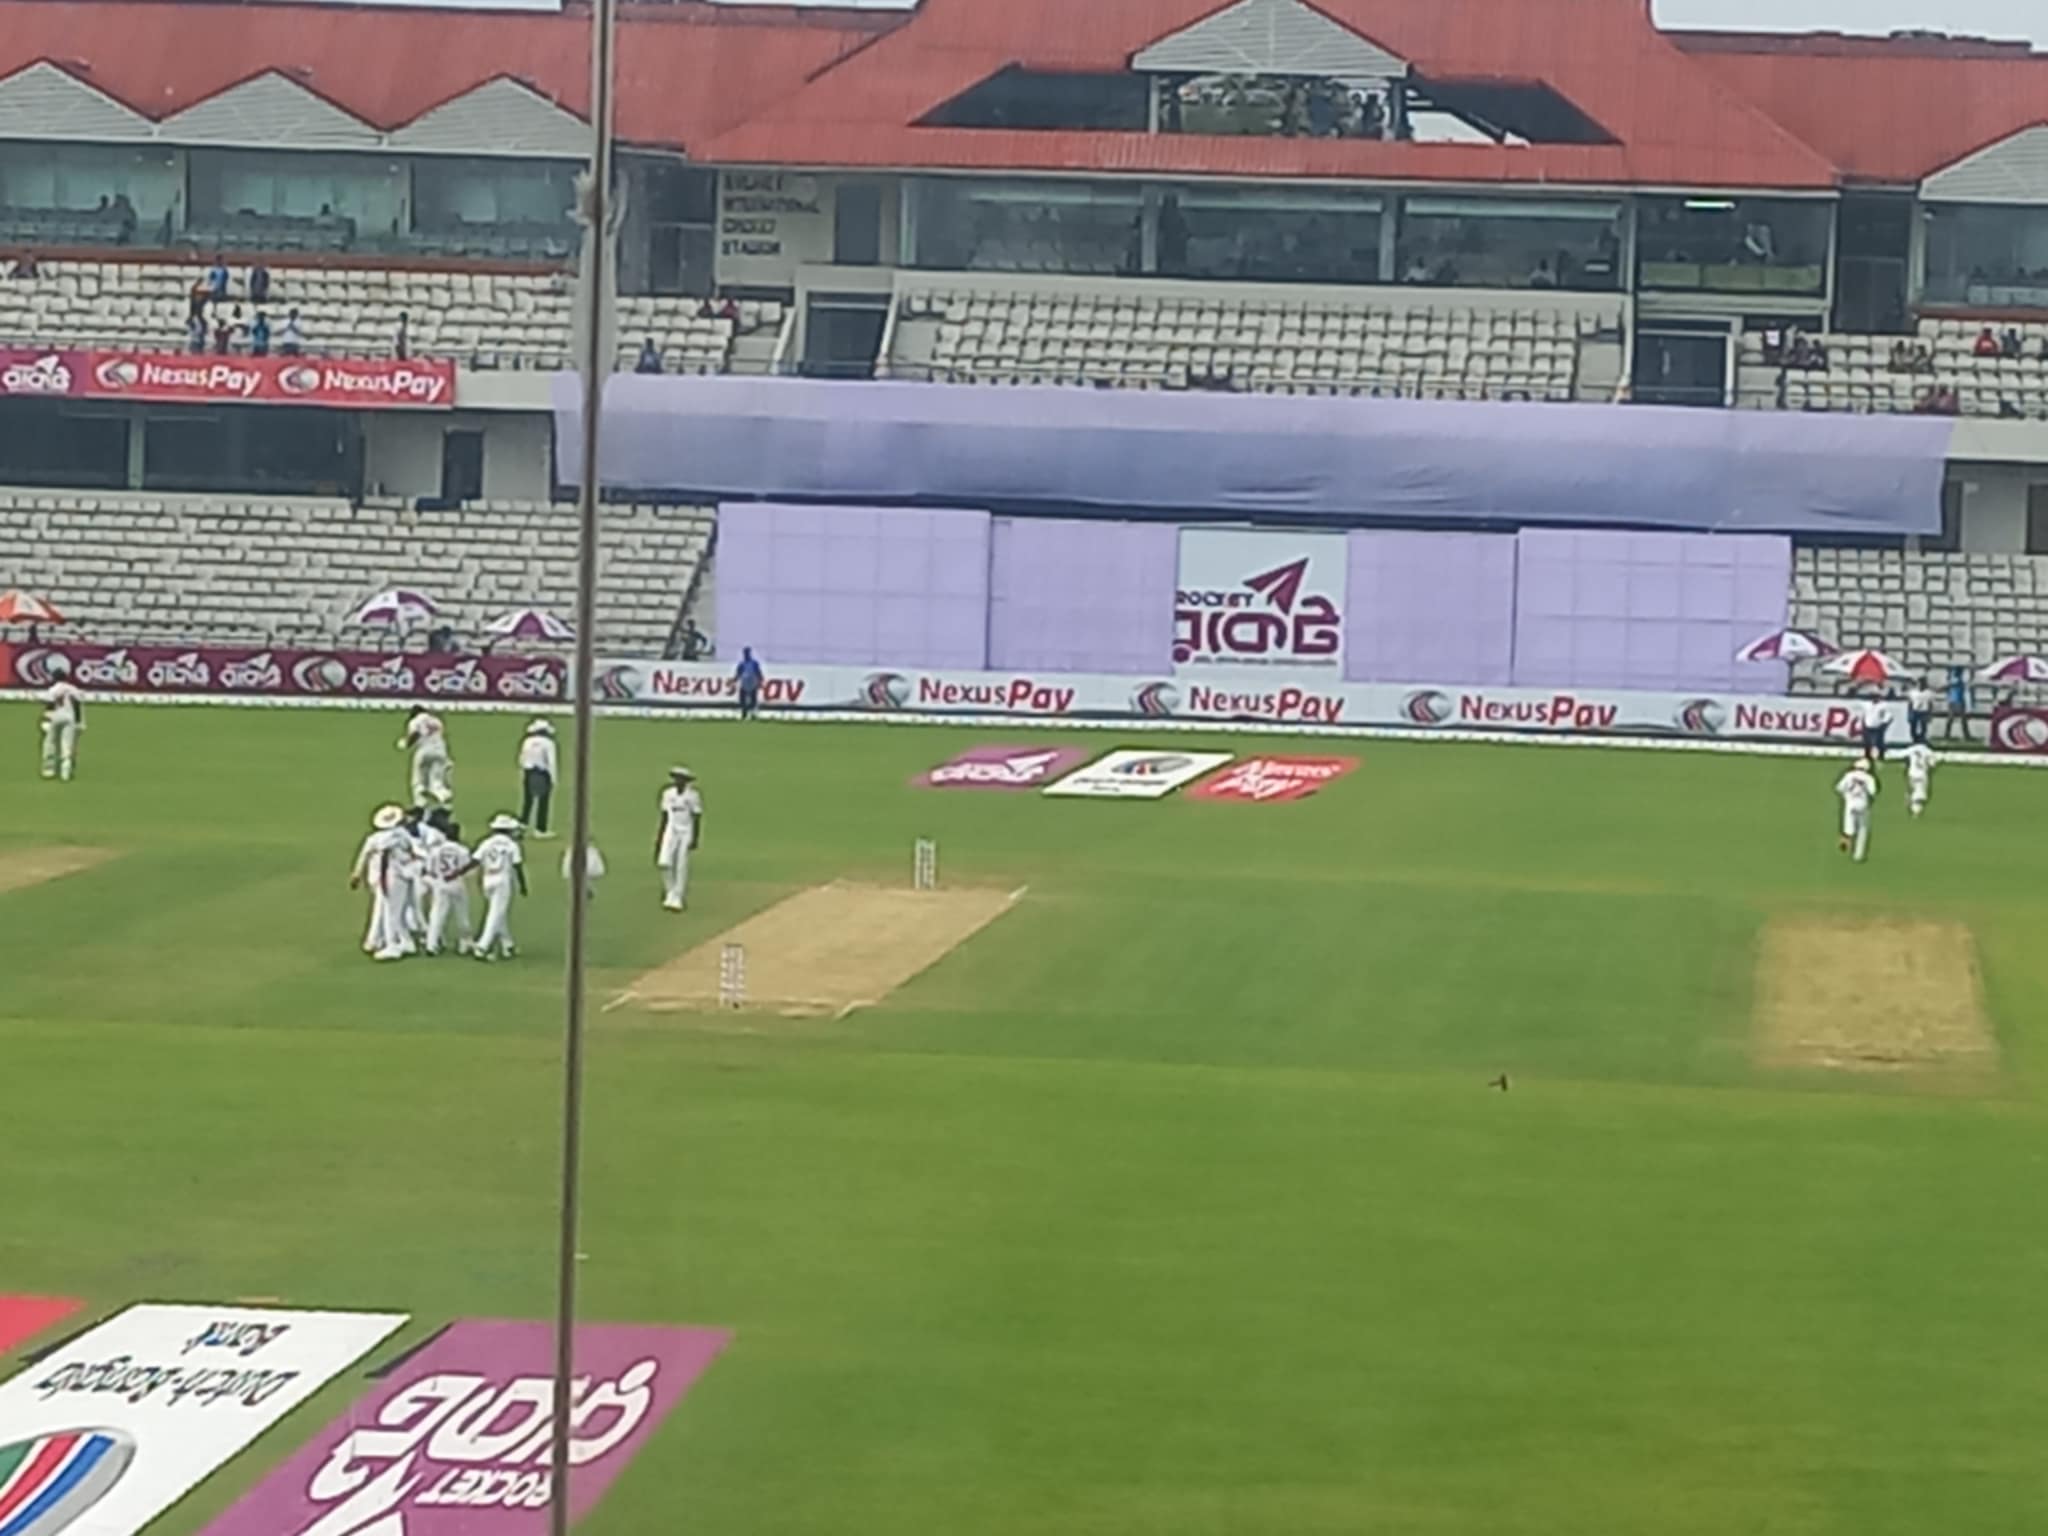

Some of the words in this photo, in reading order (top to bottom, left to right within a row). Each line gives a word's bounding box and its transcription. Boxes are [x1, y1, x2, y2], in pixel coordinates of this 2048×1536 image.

[142, 363, 262, 397] NexusPay
[652, 670, 805, 702] Nexusay
[919, 677, 1075, 711] NexusPay
[1189, 686, 1345, 722] NexusPay
[1460, 695, 1618, 727] NexusPay
